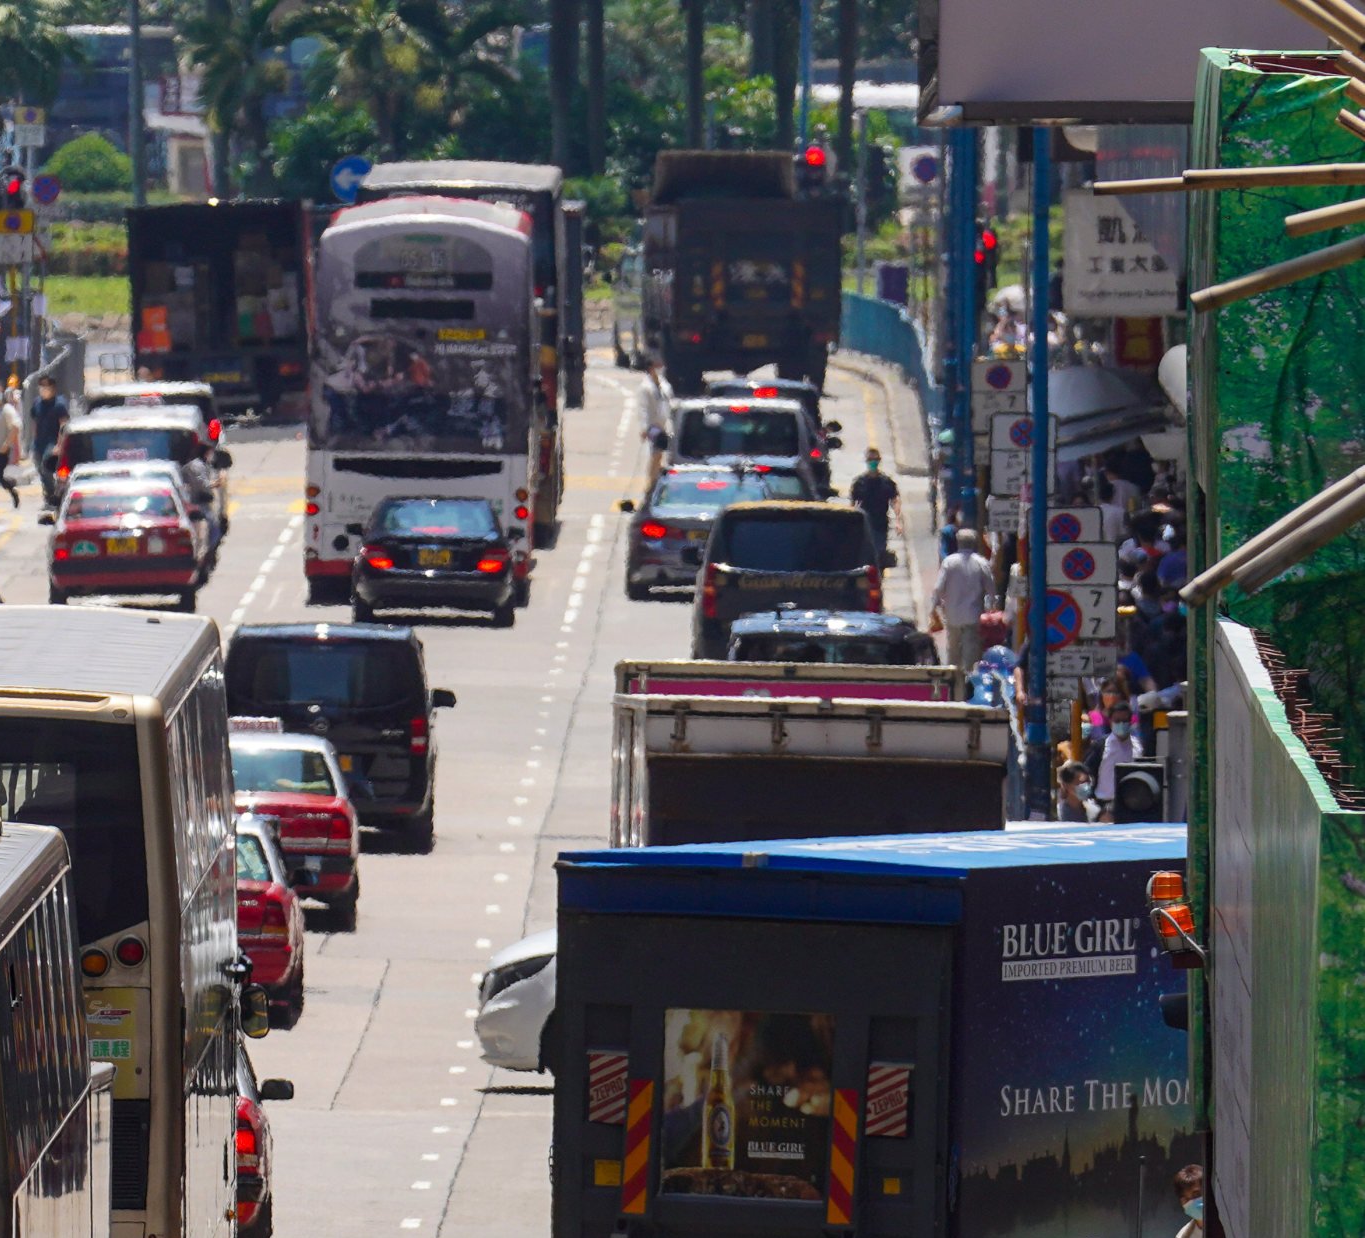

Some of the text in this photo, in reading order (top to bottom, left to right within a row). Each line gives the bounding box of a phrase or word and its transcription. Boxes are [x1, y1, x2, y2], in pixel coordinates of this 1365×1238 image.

[1090, 590, 1102, 607] 7
[1089, 617, 1102, 635] 7
[1001, 917, 1137, 960] BLUE GIRL
[1002, 956, 1134, 980] IMPORTED PREMIUM BEER
[749, 1084, 792, 1098] SHARE
[999, 1083, 1076, 1118] SHARE
[1083, 1079, 1134, 1113] THE
[749, 1101, 773, 1114] THE
[870, 1089, 906, 1117] ZEPRO
[749, 1117, 807, 1130] MOMENT
[747, 1141, 805, 1154] BLUE GIRL
